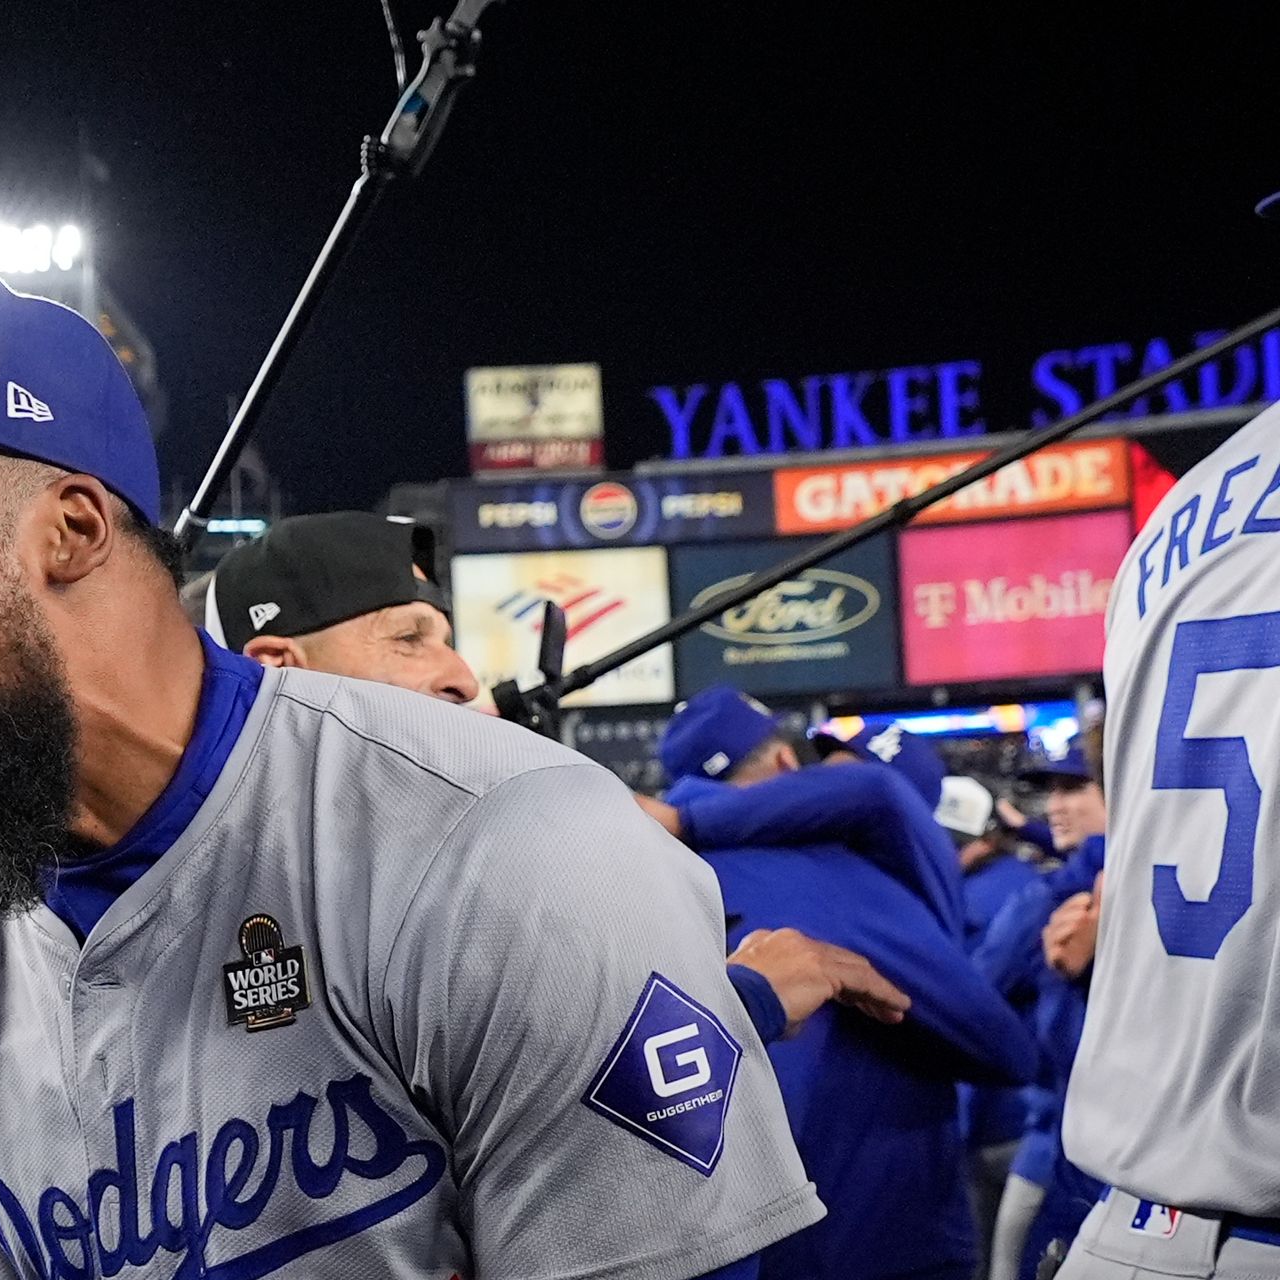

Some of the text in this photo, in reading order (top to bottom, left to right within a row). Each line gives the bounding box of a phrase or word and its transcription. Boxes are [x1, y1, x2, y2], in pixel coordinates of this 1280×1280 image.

[649, 359, 987, 459] YANKEE
[477, 502, 558, 528] PEPSI
[660, 491, 743, 520] PEPSI
[721, 580, 847, 633] Ford
[964, 569, 1115, 625] Mobile
[1152, 611, 1280, 960] 5
[227, 959, 299, 991] WORLD
[233, 978, 300, 1010] SERIES
[643, 1022, 711, 1097] G
